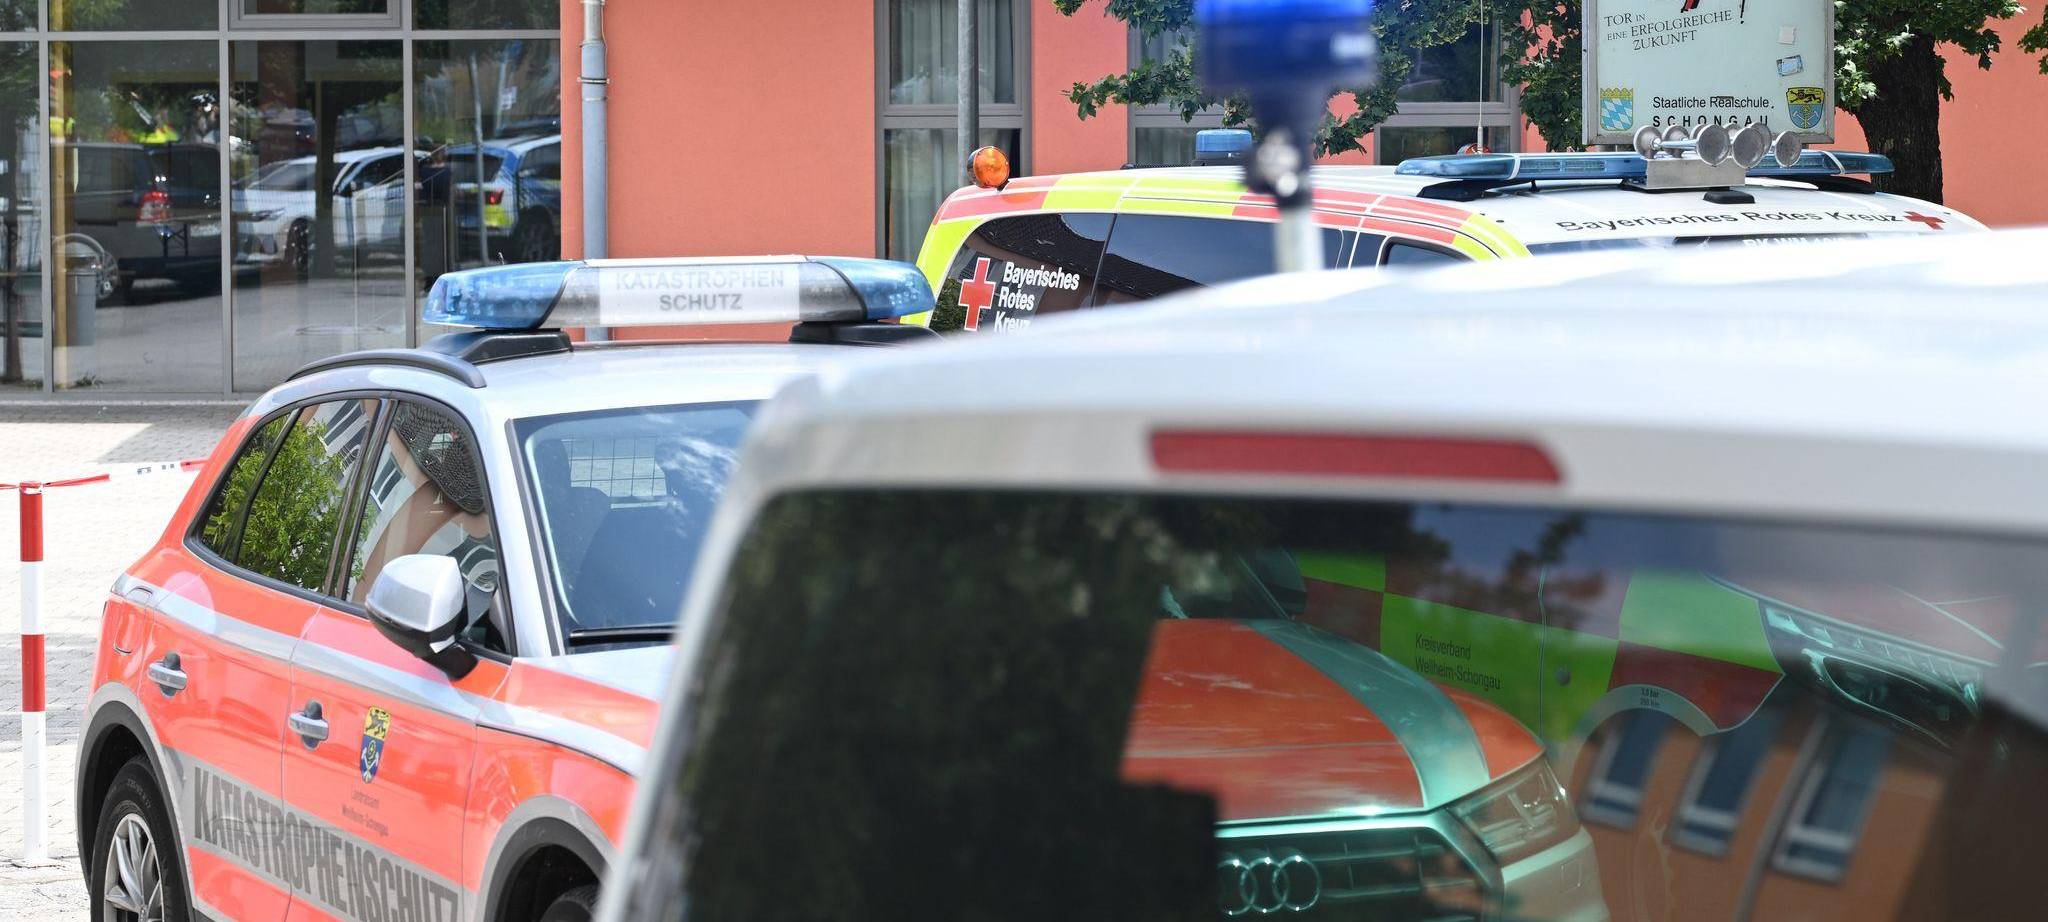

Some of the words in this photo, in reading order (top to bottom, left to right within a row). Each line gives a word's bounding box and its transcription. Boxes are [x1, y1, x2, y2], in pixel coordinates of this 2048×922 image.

[1604, 12, 1632, 27] TOR
[1635, 13, 1646, 22] IN
[1607, 30, 1628, 41] EINE
[1631, 9, 1732, 37] ERFOLGREICHE
[1633, 30, 1697, 50] ZUKUNFT
[1653, 96, 1706, 109] Staatliche
[1709, 96, 1770, 109] Realschule
[1652, 115, 1768, 127] SCHONGAU
[1556, 213, 1738, 231] Bayerisches
[1740, 211, 1823, 221] Rotes
[1825, 211, 1903, 222] Kreuz
[616, 270, 784, 290] KATASTROPHEN
[1003, 261, 1080, 290] Bayerisches
[659, 293, 743, 311] SCHUTZ
[998, 286, 1035, 311] Rotes
[994, 311, 1031, 336] Kreuz
[1415, 632, 1471, 660] Kreisverband
[1415, 656, 1501, 692] Weilheim-Schongau
